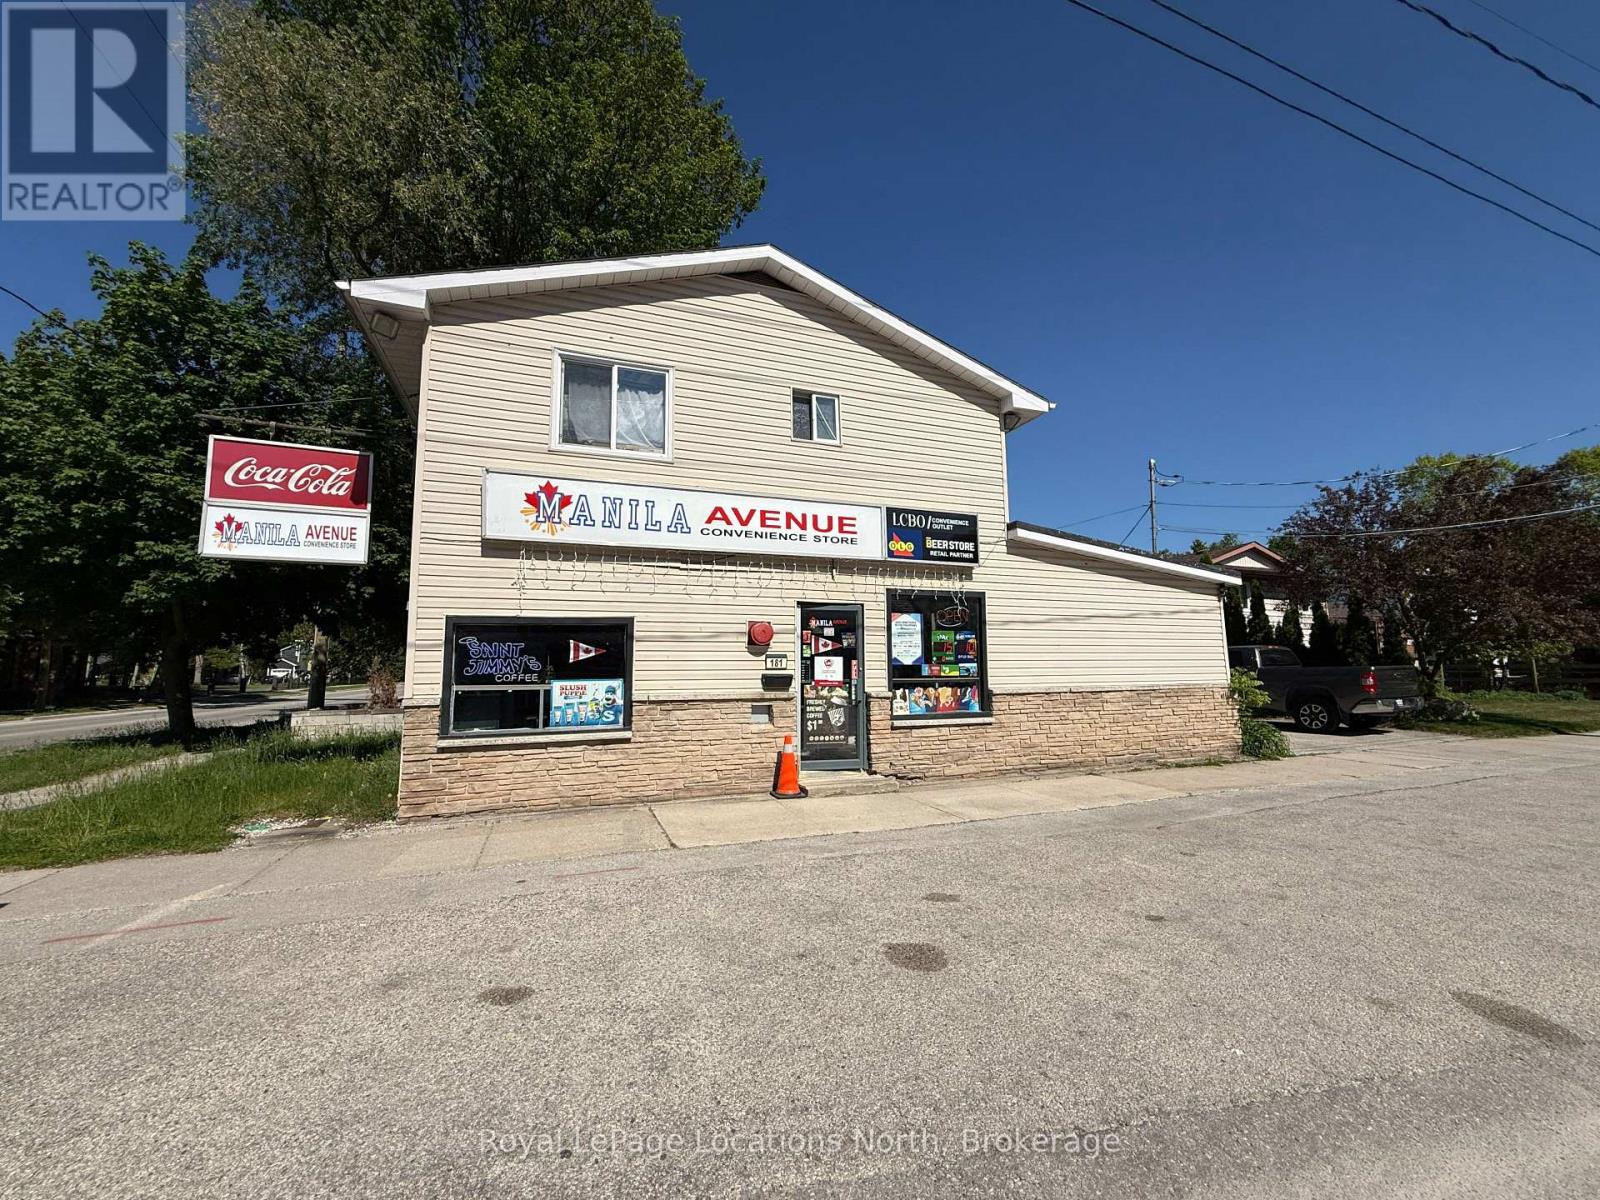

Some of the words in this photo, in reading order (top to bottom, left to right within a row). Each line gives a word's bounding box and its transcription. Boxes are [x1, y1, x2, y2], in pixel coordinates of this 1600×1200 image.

[224, 457, 358, 496] Coca-Cola
[536, 490, 692, 534] MANILA
[704, 506, 858, 534] AVENUE
[892, 512, 926, 528] LCBO
[931, 517, 969, 526] CONVENIENCE
[220, 520, 300, 547] MANILA
[305, 525, 357, 541] AVENUE
[700, 527, 807, 542] CONVENIENCE
[813, 535, 858, 545] STORE
[303, 541, 339, 549] CONVENIENCE
[926, 539, 948, 550] BEER
[949, 541, 975, 551] STORE
[469, 642, 525, 658] SAINT
[495, 673, 538, 682] COFFEE
